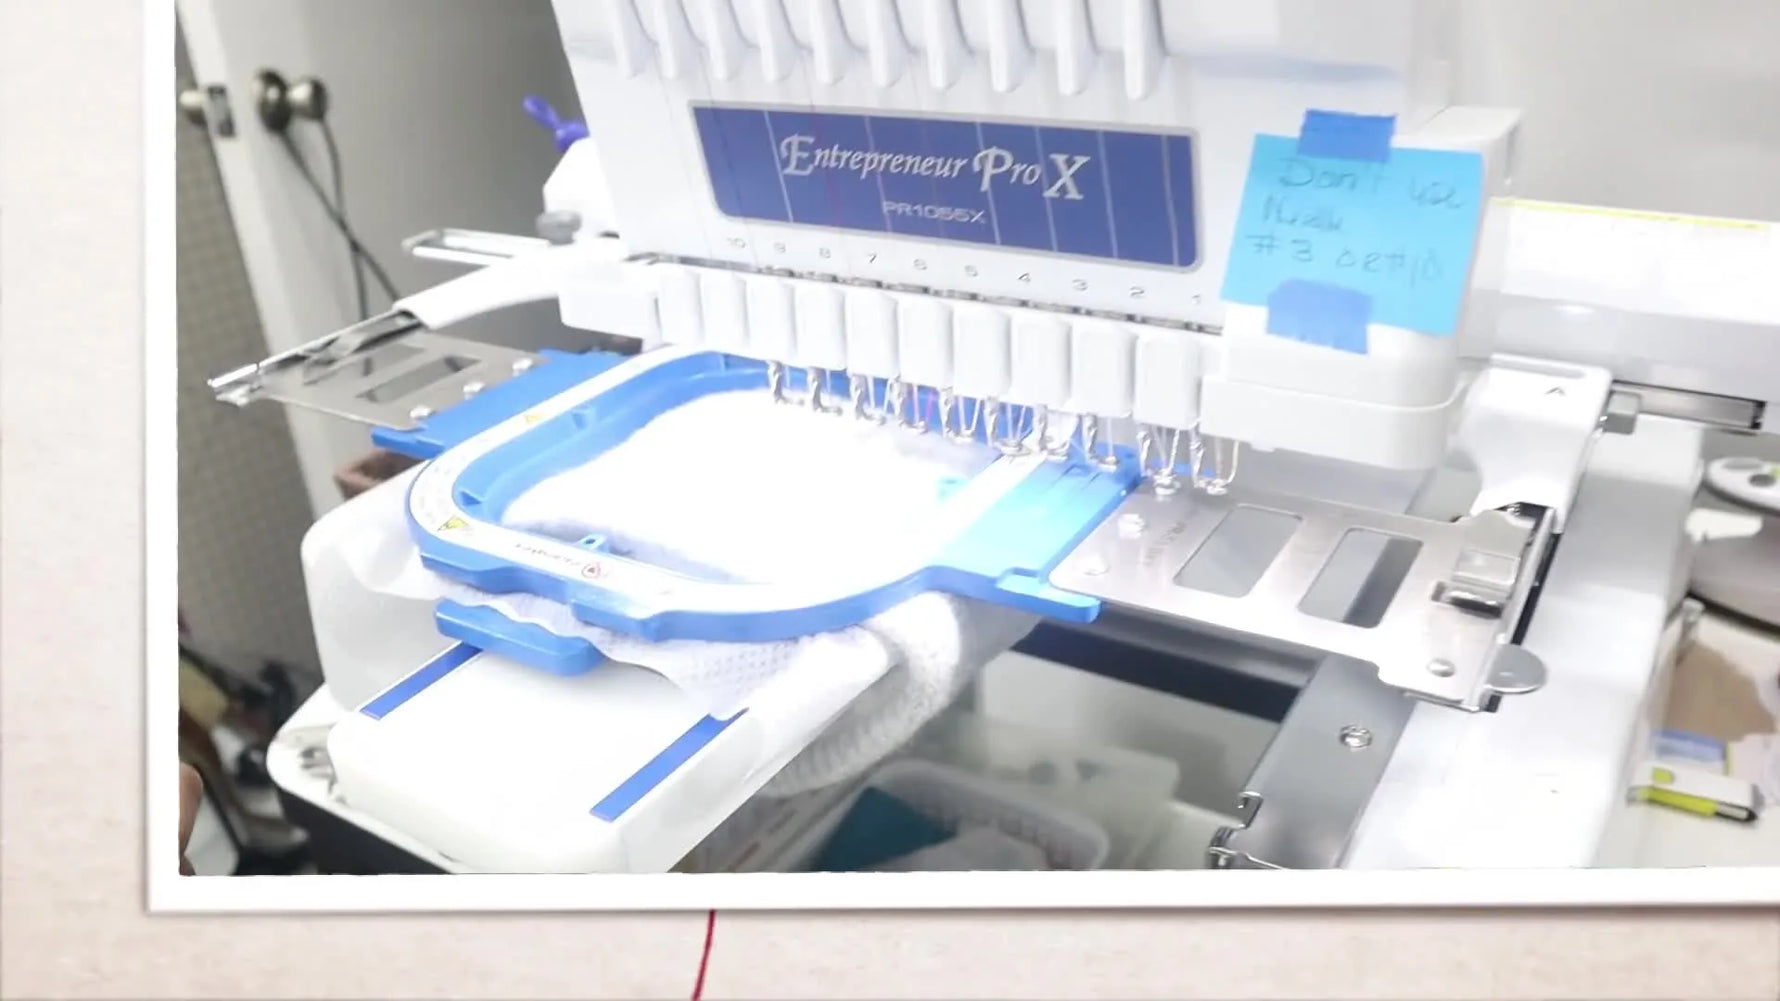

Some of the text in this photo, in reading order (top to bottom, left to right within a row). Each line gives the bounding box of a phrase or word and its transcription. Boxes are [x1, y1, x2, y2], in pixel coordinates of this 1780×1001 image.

[779, 133, 1091, 200] Entrepreneur Pro X
[867, 252, 878, 264] 7
[1018, 272, 1031, 283] 4
[1072, 278, 1088, 291] 3
[1129, 286, 1145, 298] 2
